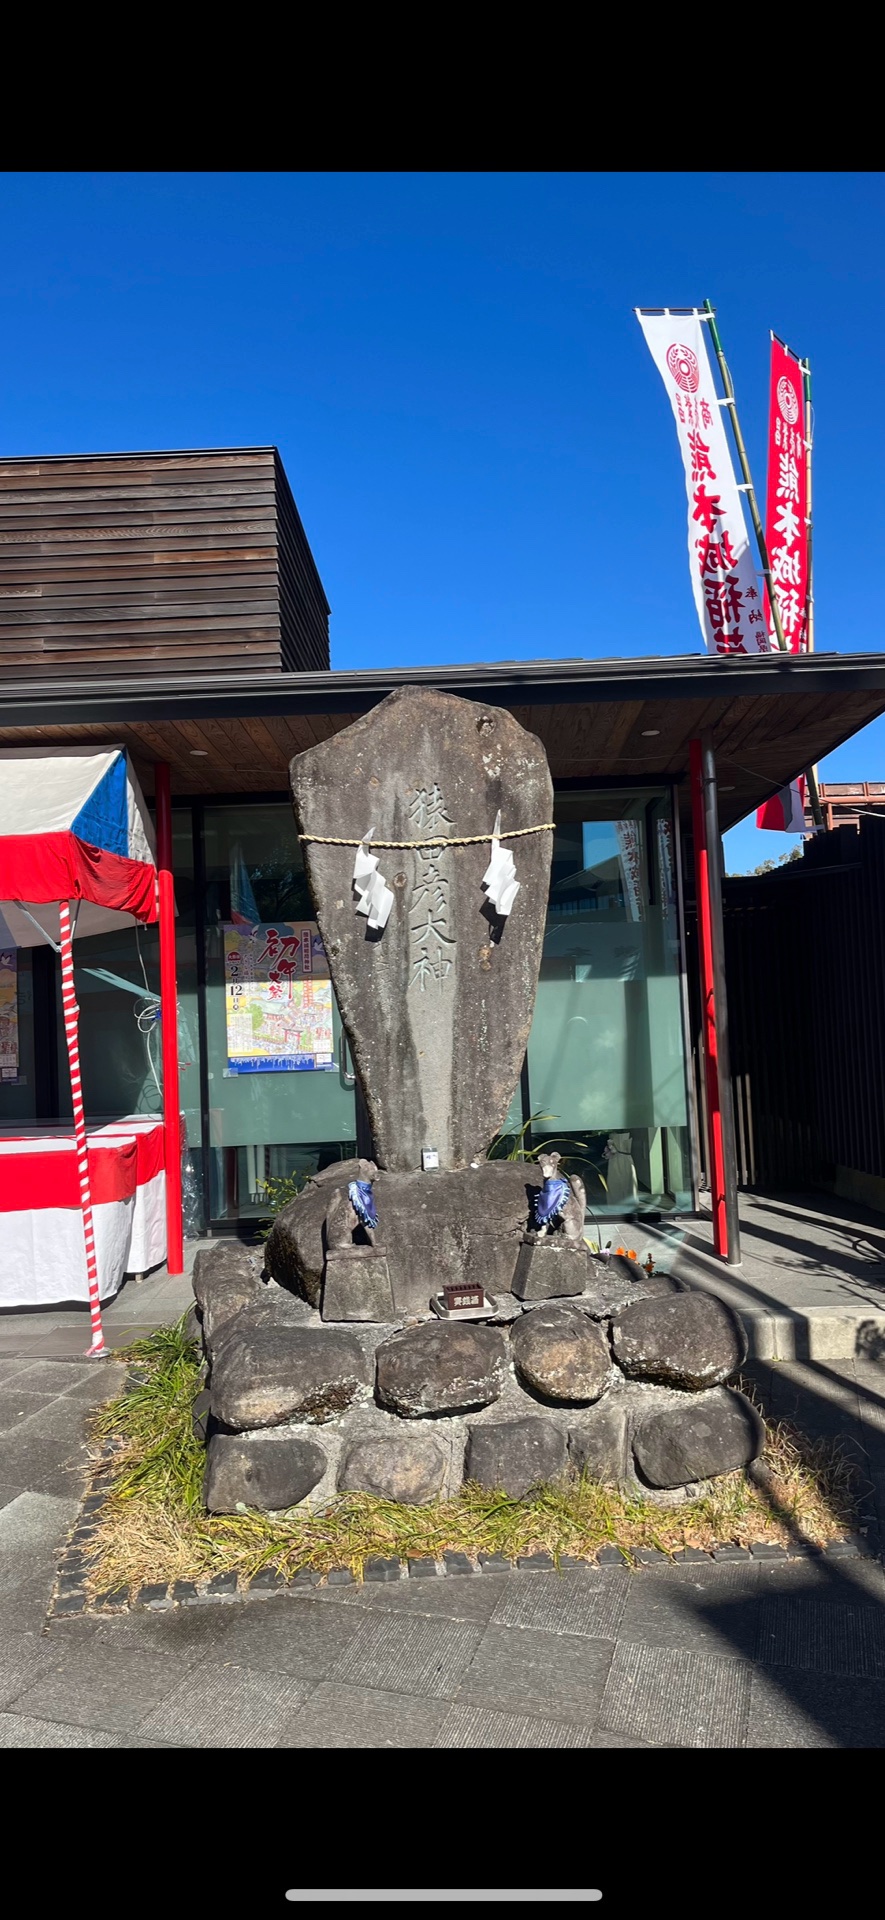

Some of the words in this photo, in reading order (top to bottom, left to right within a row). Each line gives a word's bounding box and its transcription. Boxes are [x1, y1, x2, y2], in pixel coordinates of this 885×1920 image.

[408, 782, 457, 995] 猿田彦大神
